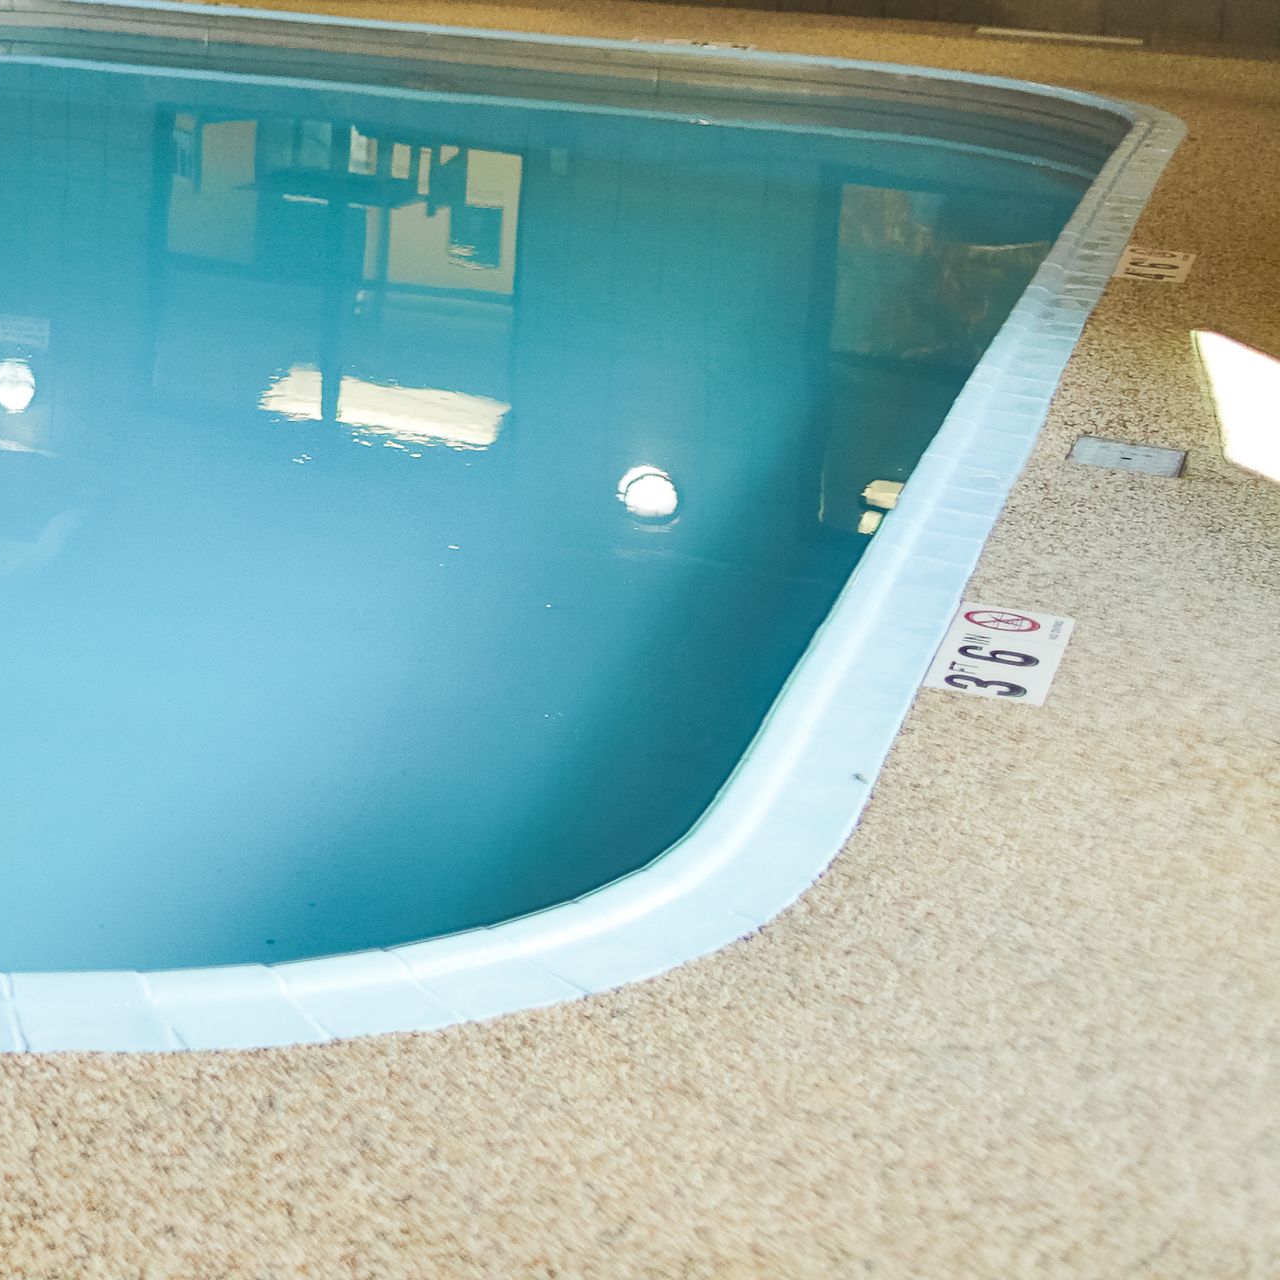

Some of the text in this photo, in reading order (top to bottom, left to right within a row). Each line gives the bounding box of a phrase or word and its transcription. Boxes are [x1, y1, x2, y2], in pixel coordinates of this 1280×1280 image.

[944, 633, 1040, 698] 3 FT 6 IN
